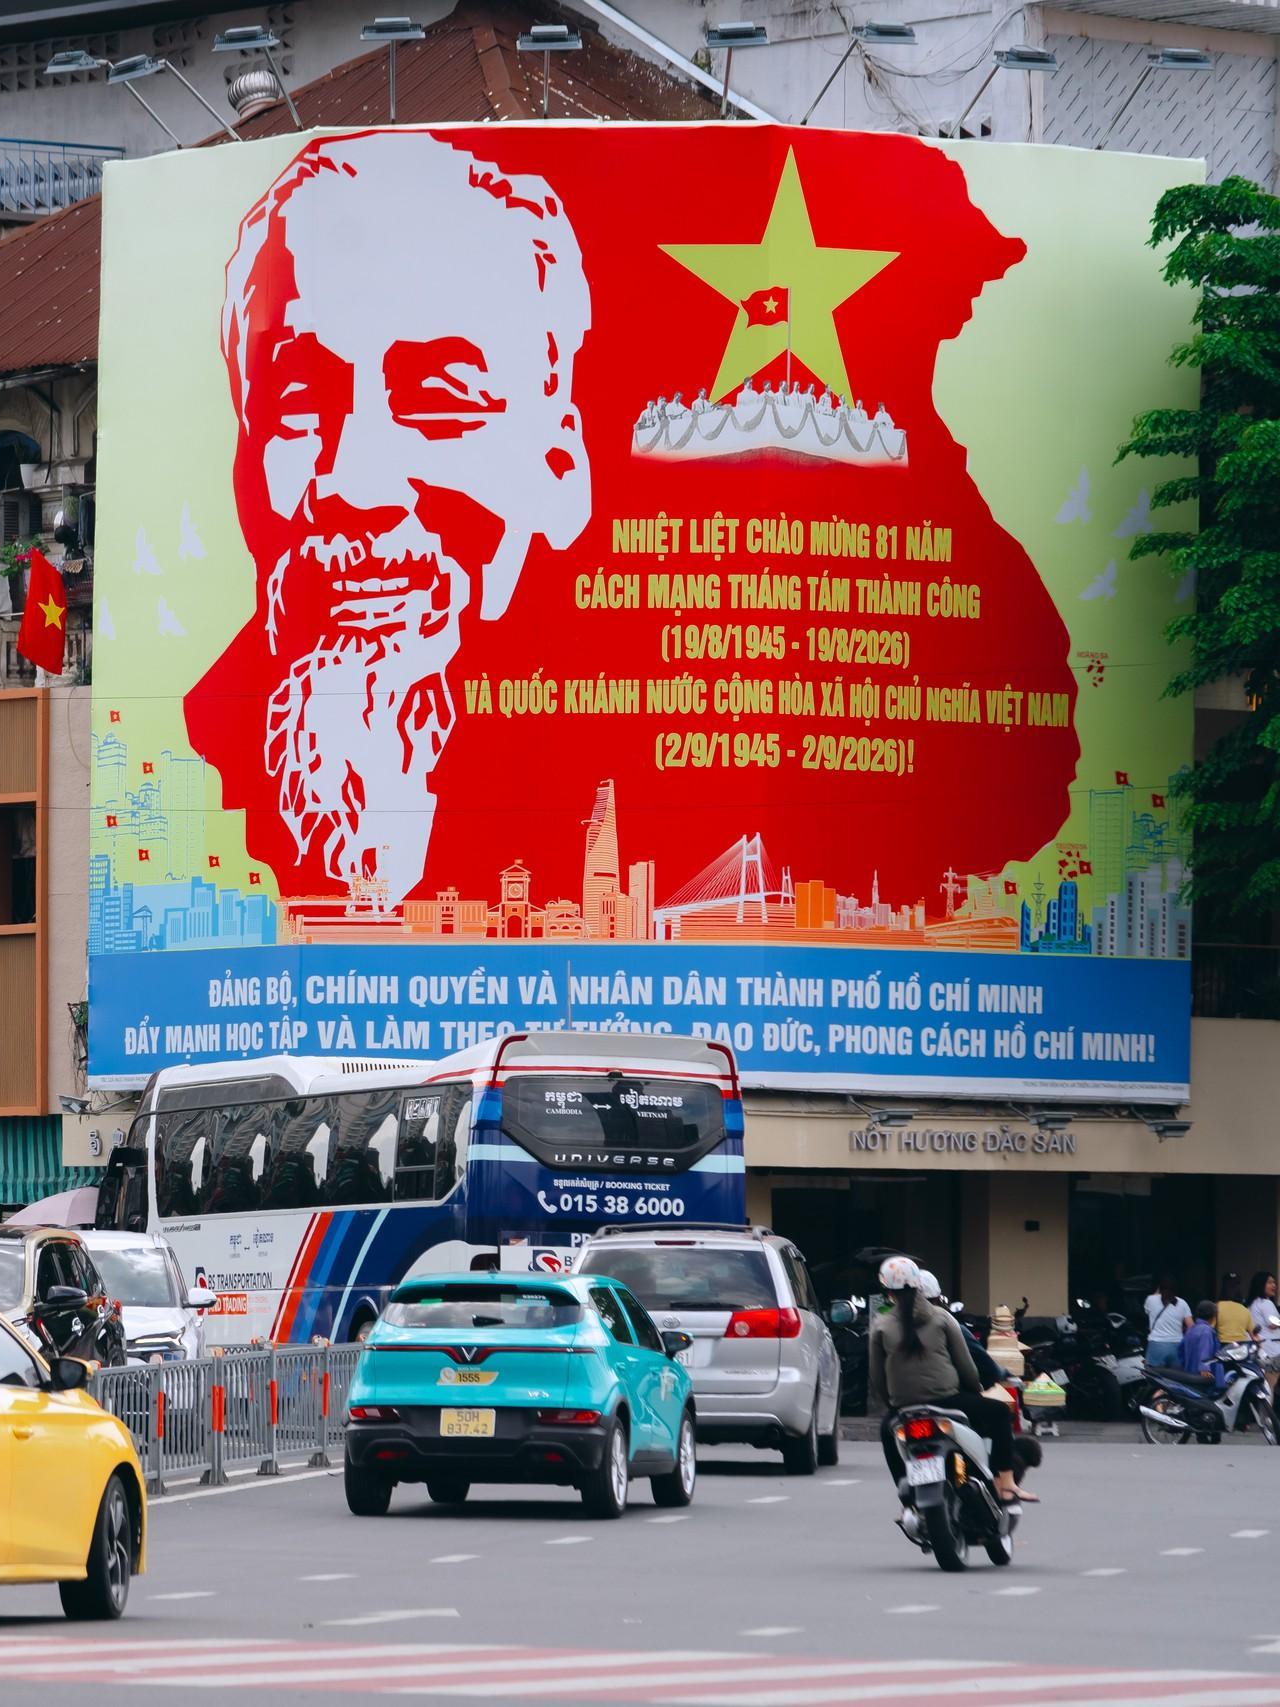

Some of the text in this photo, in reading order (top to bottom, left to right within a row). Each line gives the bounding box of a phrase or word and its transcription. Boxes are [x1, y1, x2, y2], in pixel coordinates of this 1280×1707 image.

[612, 511, 952, 562] NHIỆT LIỆT CHÀO MỪNG 81 NĂM
[575, 567, 981, 619] CÁCH MẠNG THÁNG TÁM THÀNH CÔNG
[661, 624, 785, 663] (19/8/1945
[806, 627, 910, 669] 19/8/2026)
[464, 668, 1070, 733] VÀ QUỐC KHÁNH NƯỚC CỘNG HÒA XÃ HỘI CHỦ NGHĨA VIỆT NAM
[655, 732, 780, 771] (2/9/1945
[802, 735, 915, 777] 2/9/2026)!
[208, 966, 1043, 1015] ĐẢNG BỘ, CHÍNH QUYỀN VÀ NHÂN DÂN THÀNH PHỐ HỒ CHÍ MINH
[124, 1015, 160, 1055] ĐẨY
[165, 1023, 221, 1059] MẠNH
[226, 1022, 264, 1057] HỌC
[269, 1015, 308, 1055] TẬP
[316, 1014, 357, 1050] VÀ
[366, 1014, 430, 1050] LÀM
[763, 1017, 821, 1057] ĐỨC,
[829, 1024, 913, 1057] PHONG
[920, 1022, 986, 1059] CÁCH
[994, 1020, 1026, 1059] HỒ
[1035, 1026, 1075, 1061] CHÍ
[1081, 1033, 1156, 1063] MINH!
[636, 1111, 668, 1119] VIETNAM
[852, 1123, 892, 1151] NỐT
[901, 1130, 978, 1151] HƯƠNG
[605, 1181, 643, 1190] BOOKING
[644, 1182, 671, 1191] TICKET
[560, 1193, 685, 1216] 015 38 6000
[208, 1271, 273, 1290] BS TRANSPORTATION
[223, 1296, 247, 1313] TRADING
[458, 1373, 480, 1383] 1555
[446, 1423, 488, 1434] 837.42
[456, 1411, 480, 1422] 50H
